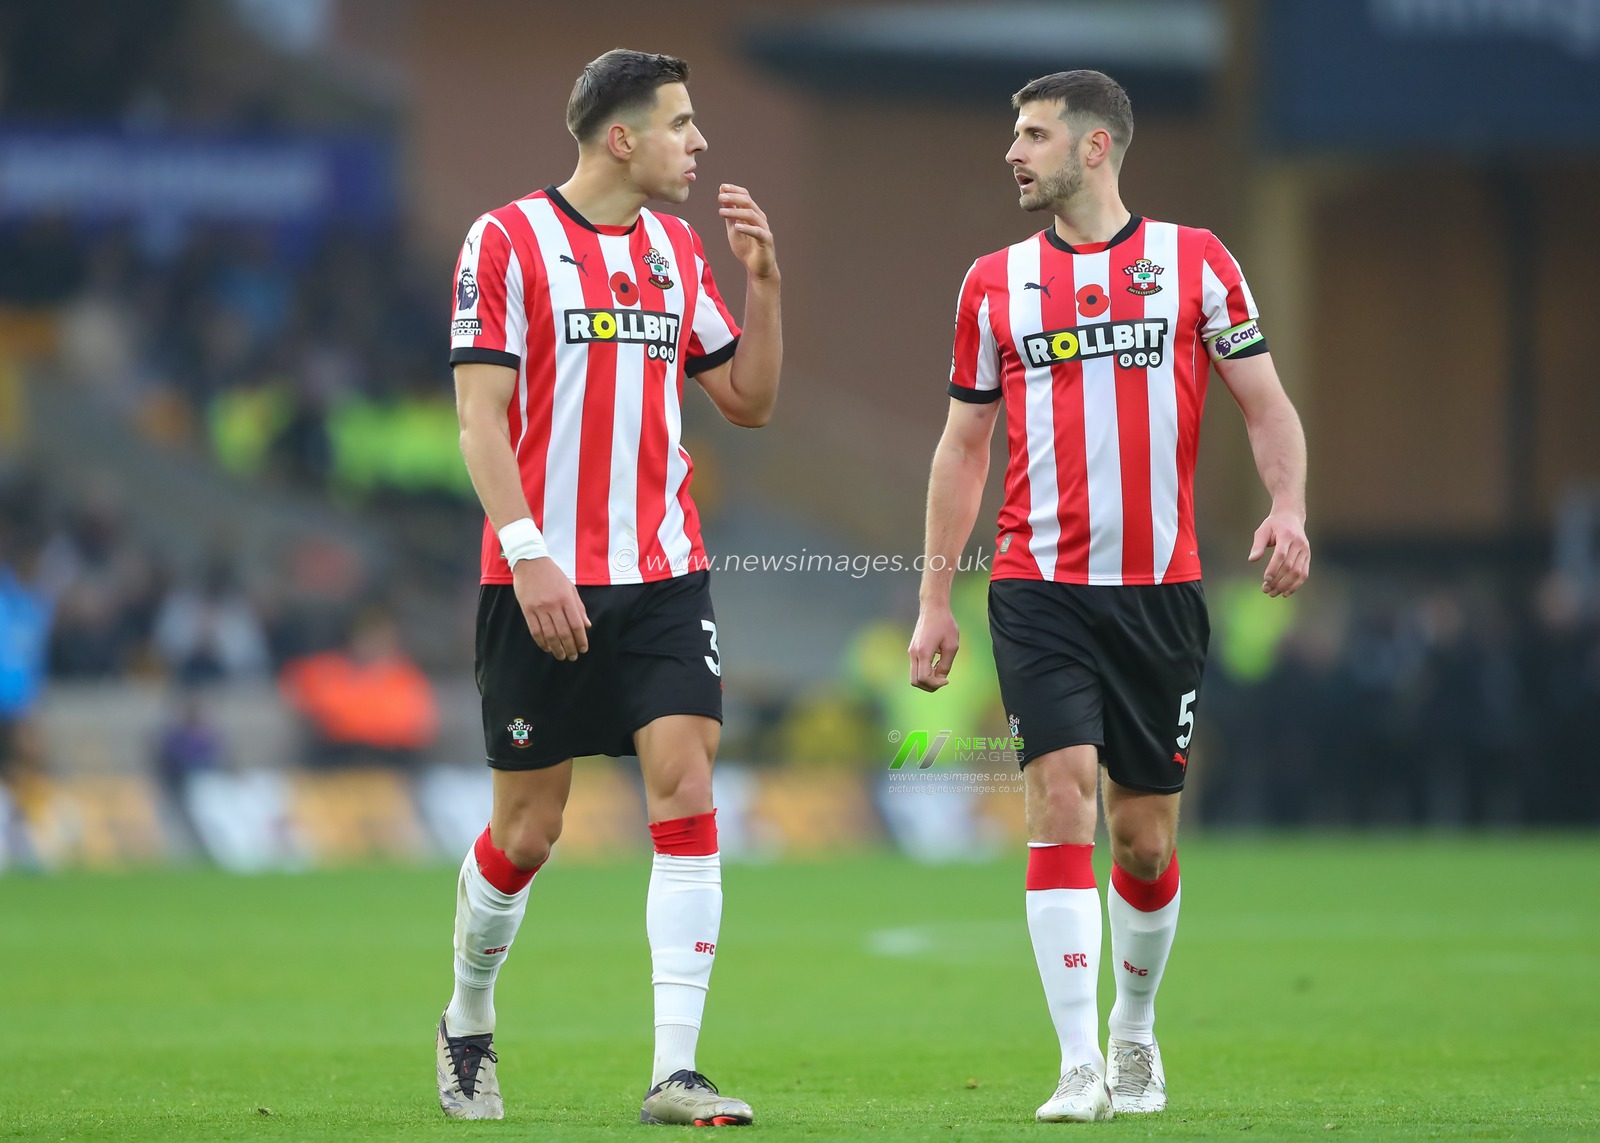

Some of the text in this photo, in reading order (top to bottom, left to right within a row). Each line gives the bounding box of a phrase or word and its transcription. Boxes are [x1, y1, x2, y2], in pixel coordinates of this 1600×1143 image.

[568, 312, 678, 344] ROLLBIT
[1027, 322, 1164, 364] ROLLBIT
[700, 619, 721, 677] 3
[1176, 689, 1196, 749] 5
[695, 941, 715, 956] SFC
[1063, 953, 1088, 968] SFC
[1123, 960, 1148, 977] SFC
